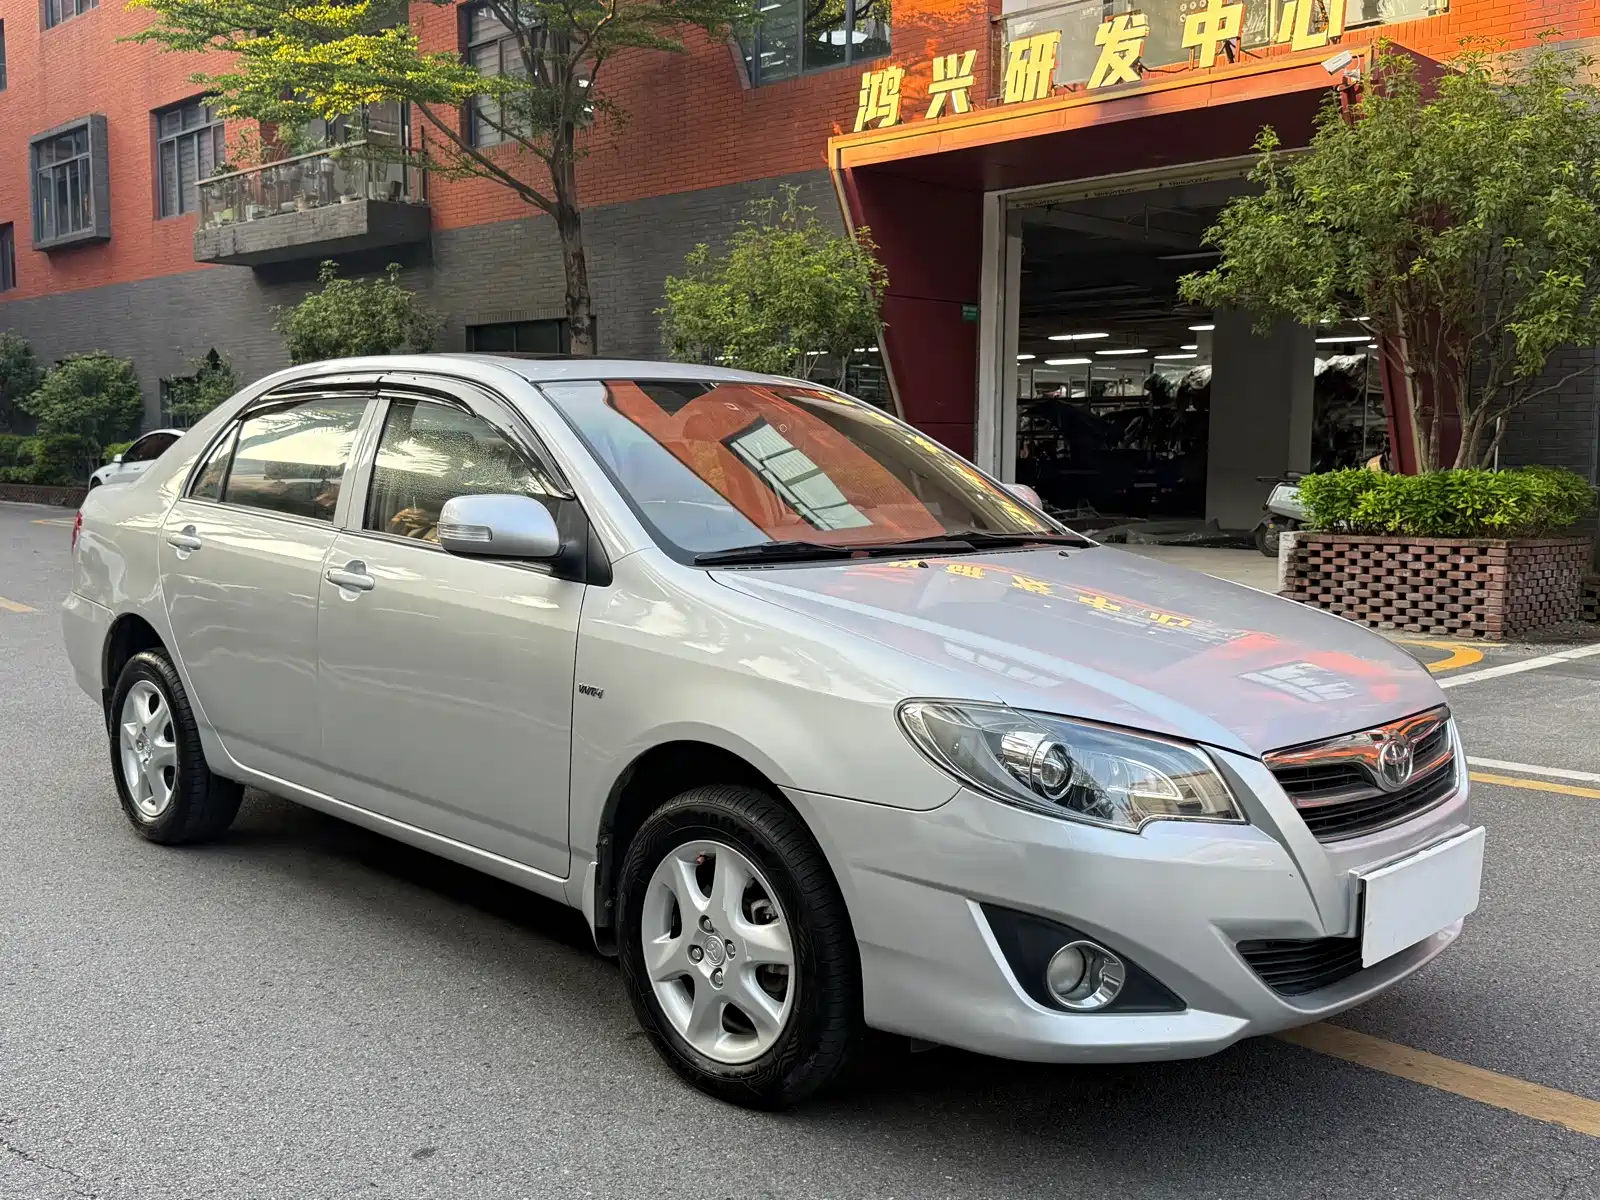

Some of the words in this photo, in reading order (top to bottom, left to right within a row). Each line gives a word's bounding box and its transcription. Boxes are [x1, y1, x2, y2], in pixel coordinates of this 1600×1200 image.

[853, 0, 1344, 133] 鸿兴研发中心
